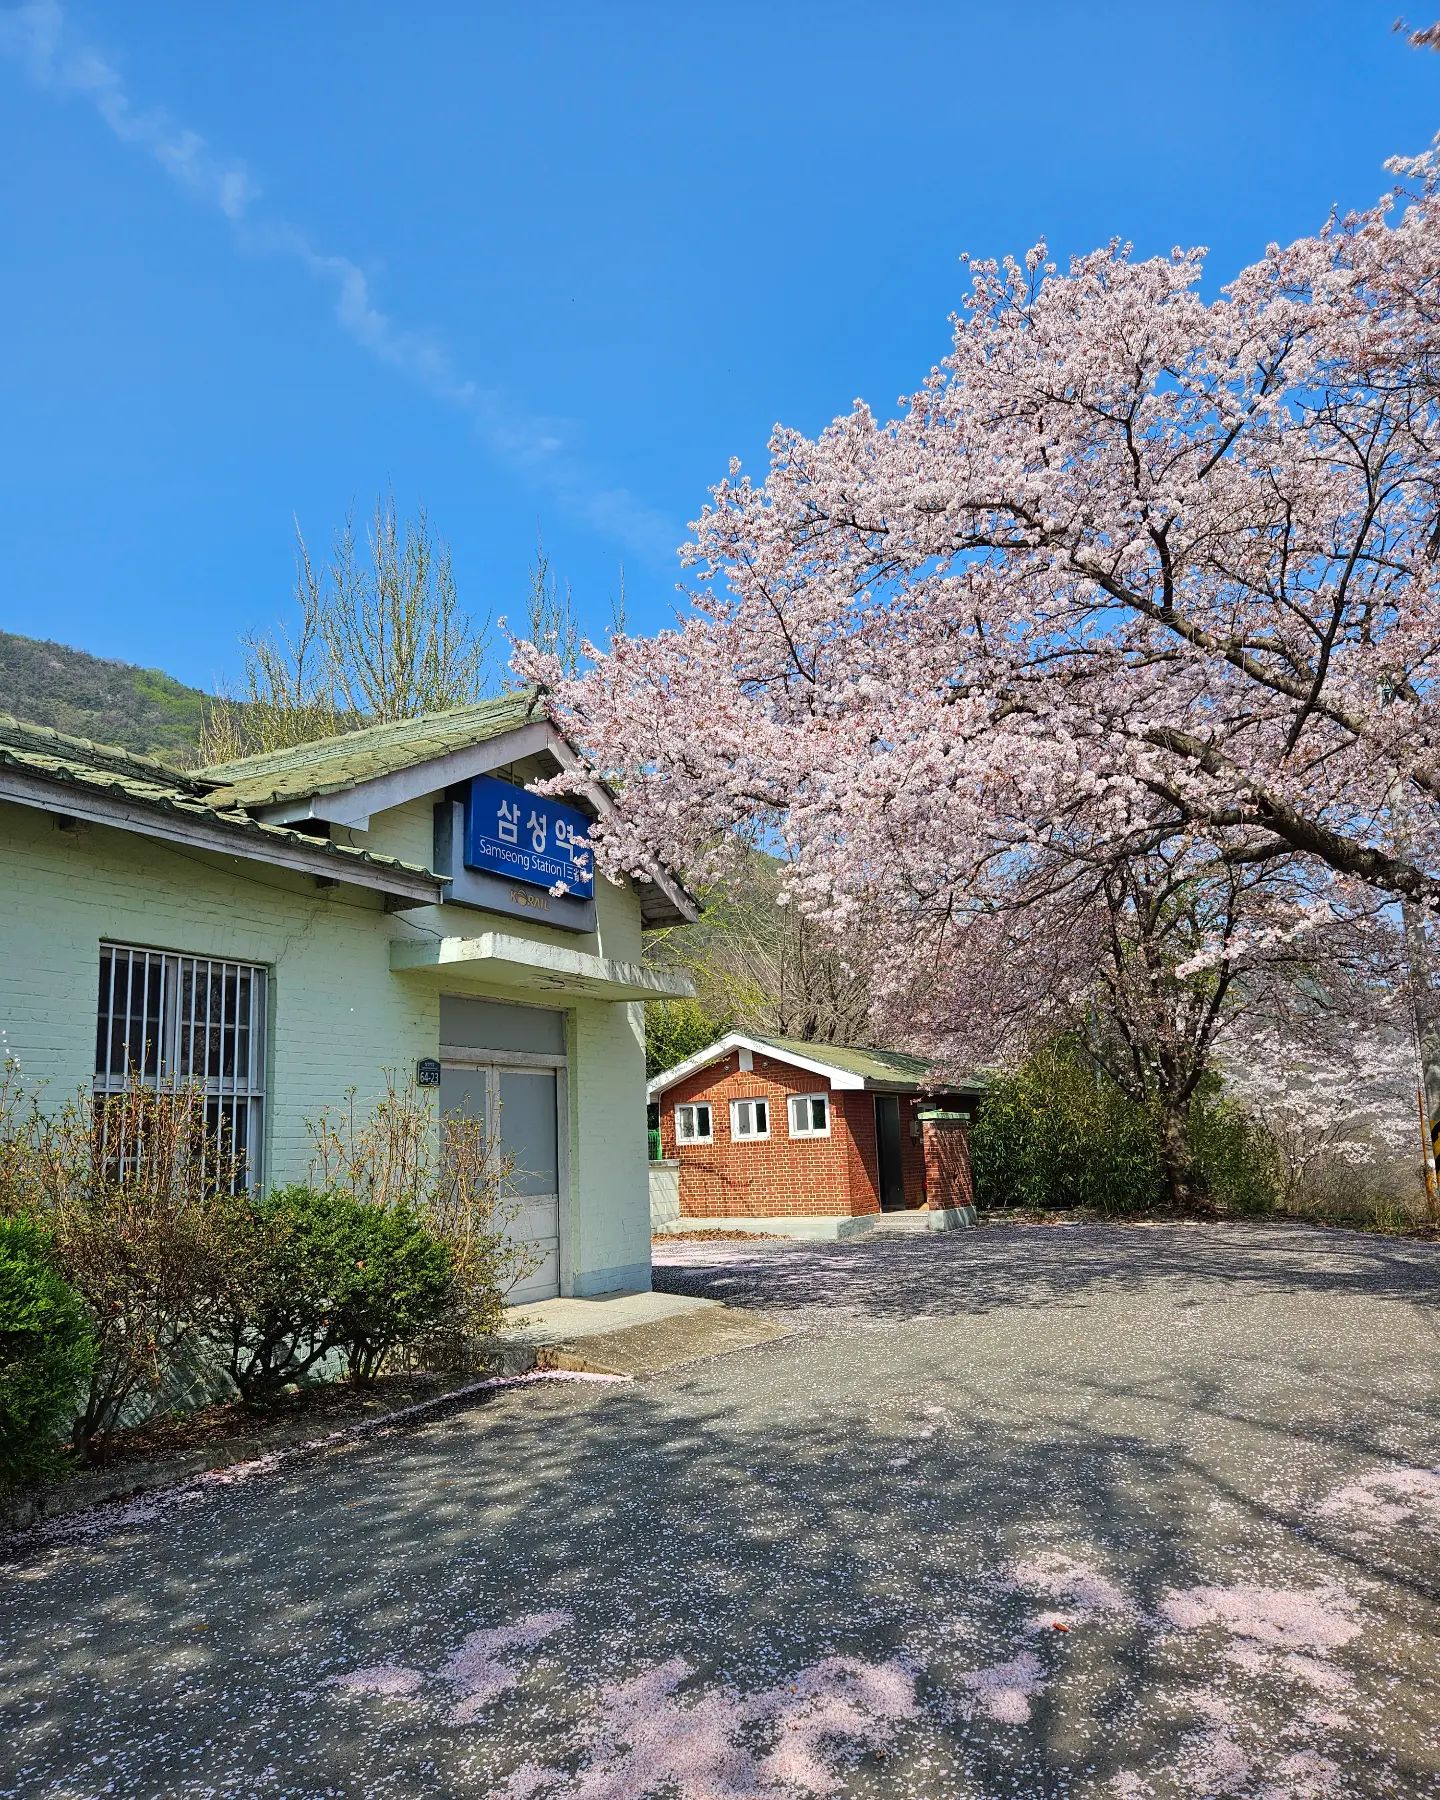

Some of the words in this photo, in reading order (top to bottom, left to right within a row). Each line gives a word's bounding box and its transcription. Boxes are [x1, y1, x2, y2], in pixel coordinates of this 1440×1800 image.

[497, 800, 574, 861] 삼성역
[479, 839, 529, 870] Samseong
[531, 855, 562, 876] Station
[510, 889, 550, 912] KORAIL
[420, 1071, 439, 1083] 64-23
